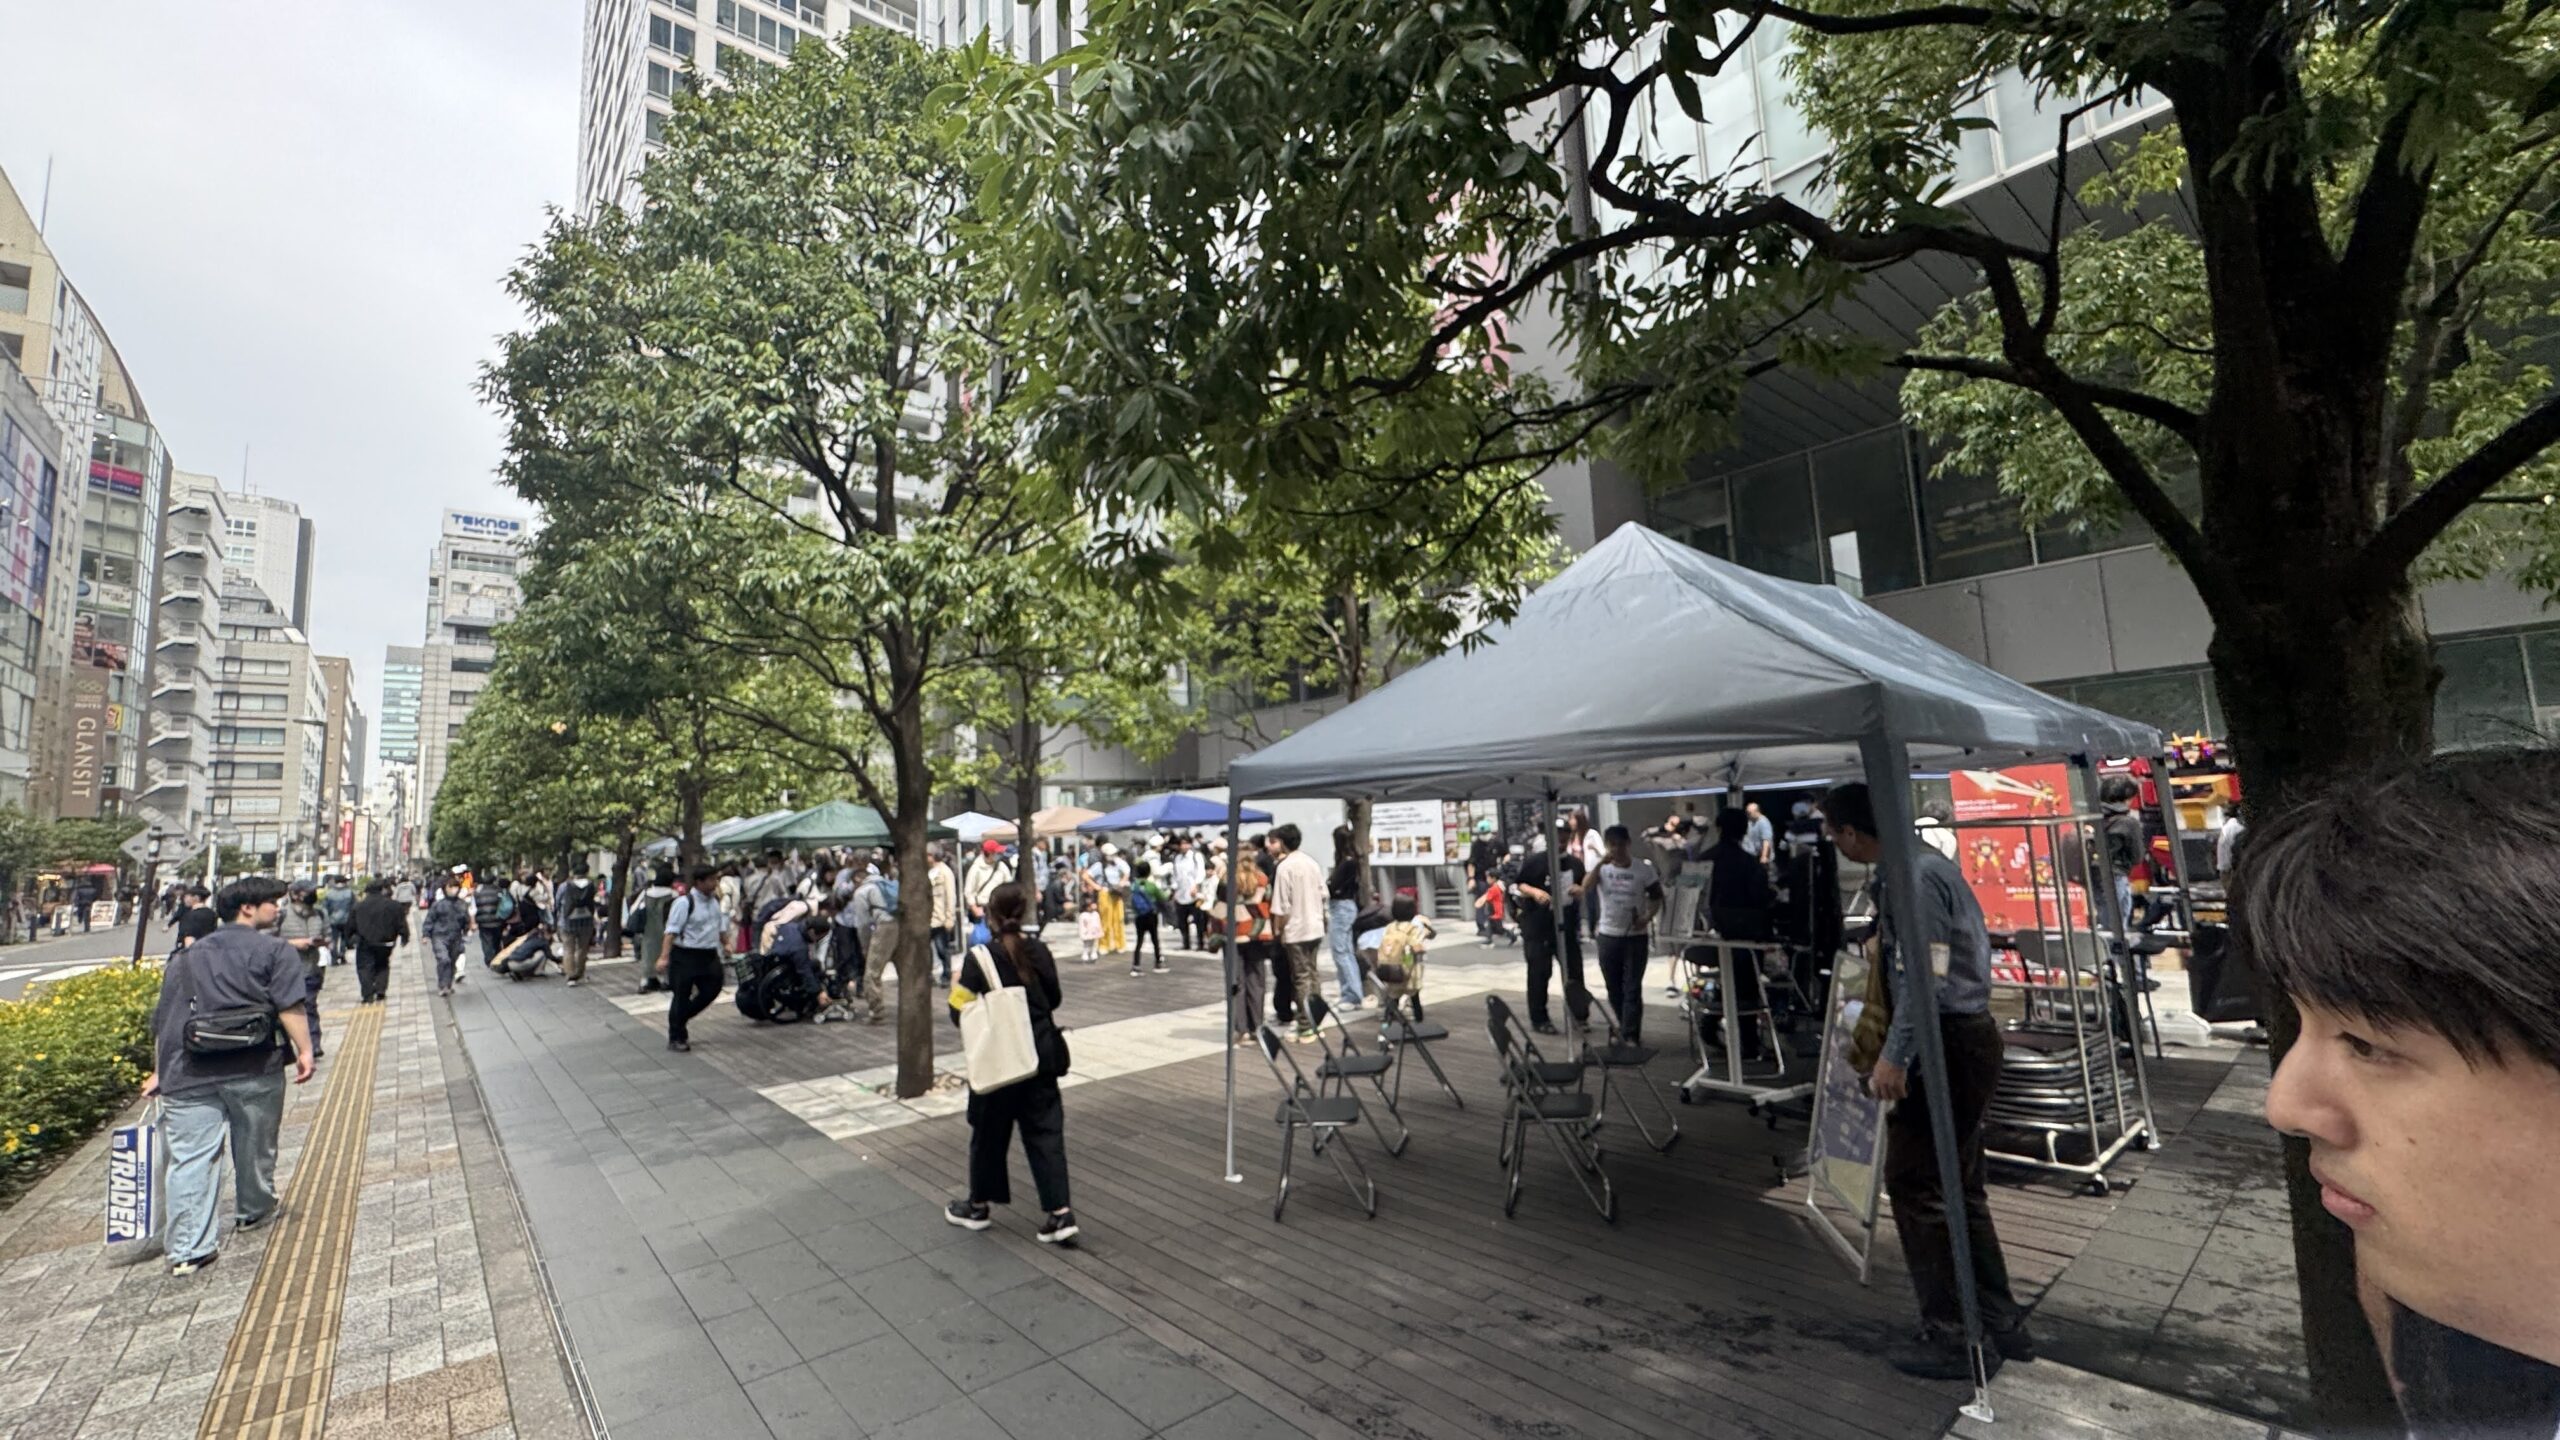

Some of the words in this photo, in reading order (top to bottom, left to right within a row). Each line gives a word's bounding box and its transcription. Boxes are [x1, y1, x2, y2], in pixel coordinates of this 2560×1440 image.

[451, 513, 520, 531] TEKNOS
[71, 716, 97, 798] GLANSIT
[109, 1150, 137, 1238] TRADER
[137, 1161, 146, 1193] HOBBY
